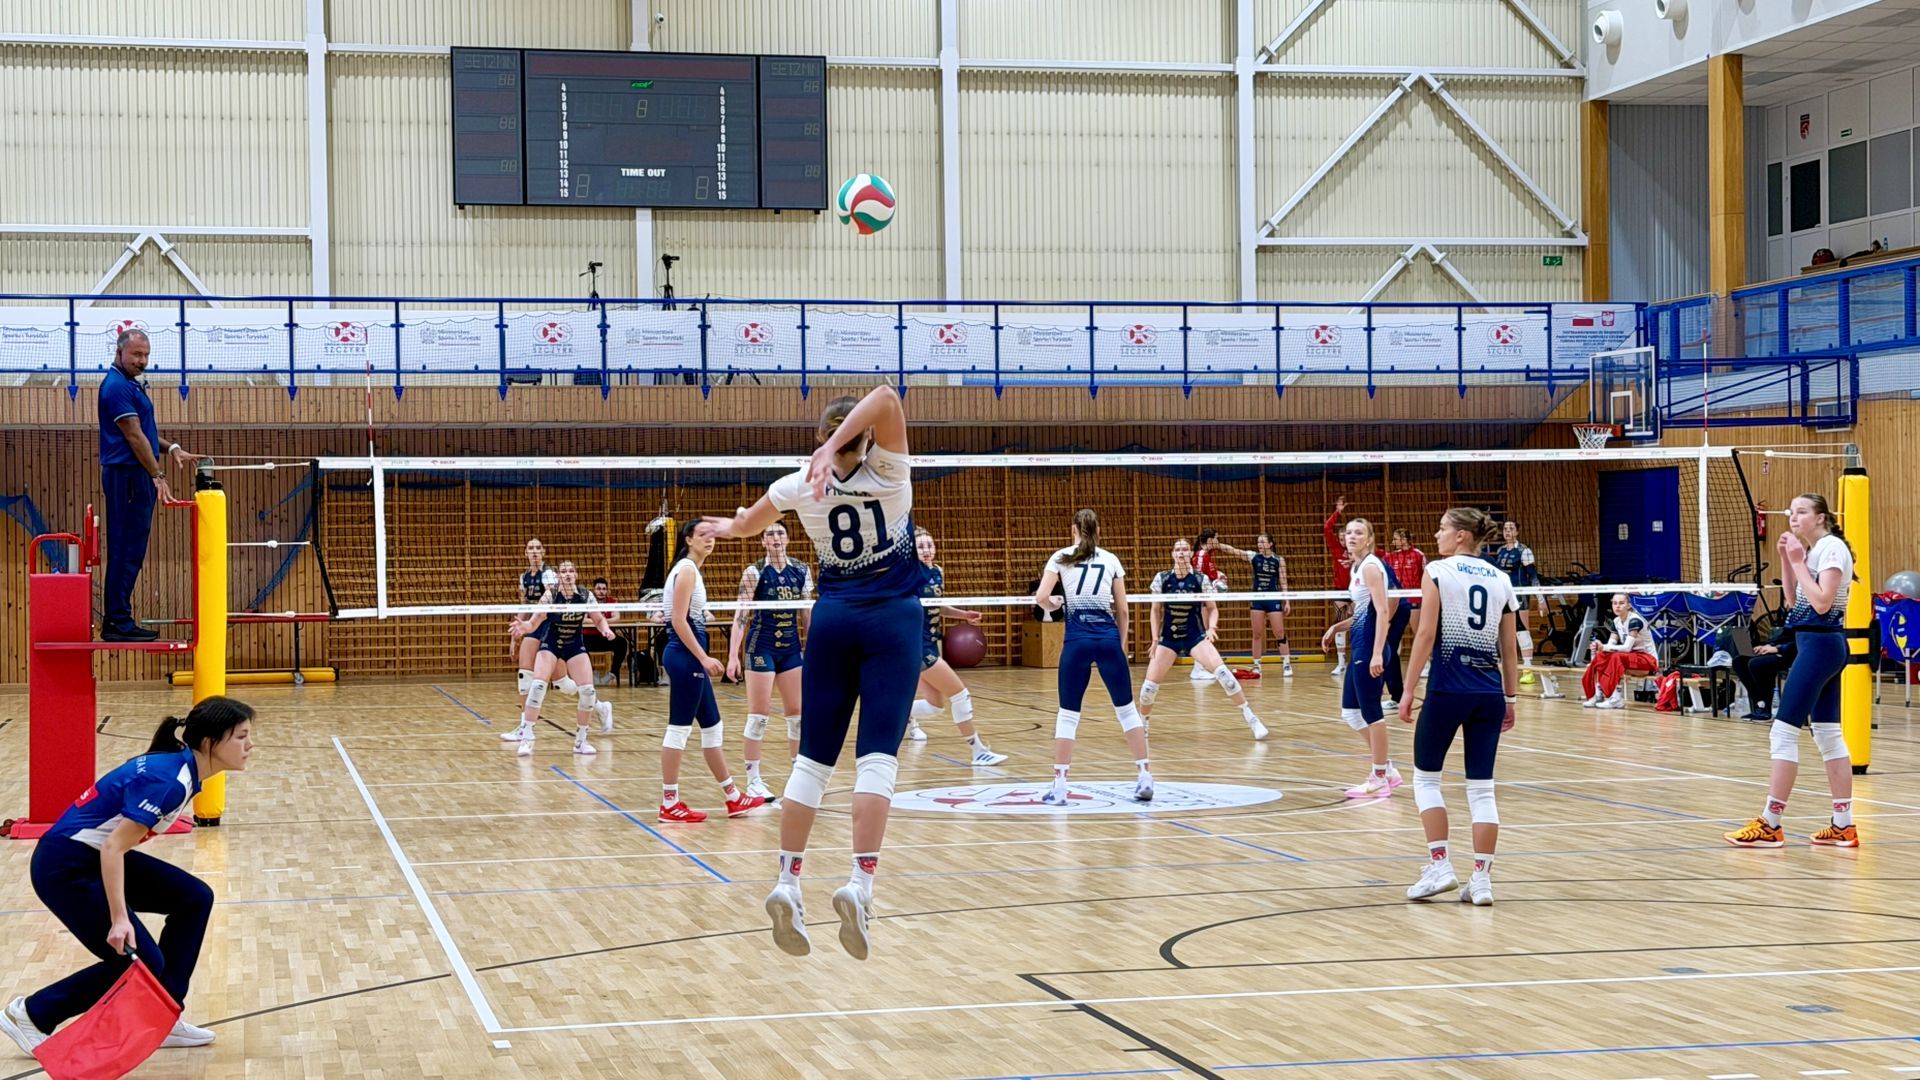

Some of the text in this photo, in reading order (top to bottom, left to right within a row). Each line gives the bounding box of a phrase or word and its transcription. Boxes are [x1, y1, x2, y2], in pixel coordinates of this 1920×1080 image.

[561, 82, 566, 91] 4
[720, 86, 726, 95] 4
[561, 92, 567, 101] 5
[720, 96, 726, 105] 5
[561, 102, 567, 111] 6
[720, 105, 726, 114] 6
[562, 112, 567, 120] 7
[720, 115, 726, 124] 7
[562, 121, 567, 130] 8
[721, 125, 726, 133] 8
[562, 131, 568, 140] 9
[721, 134, 726, 143] 9
[559, 141, 568, 149] 10
[717, 143, 726, 152] 10
[559, 150, 567, 159] 11
[717, 153, 726, 162] 11
[559, 160, 568, 168] 12
[717, 162, 726, 171] 12
[559, 170, 568, 178] 13
[621, 168, 666, 177] TIME OUT
[717, 172, 726, 181] 13
[560, 179, 568, 188] 14
[717, 181, 726, 190] 14
[560, 189, 568, 197] 15
[718, 191, 726, 200] 15
[829, 499, 894, 560] 81
[1074, 564, 1105, 595] 77
[777, 586, 792, 600] 36
[1468, 584, 1488, 630] 9
